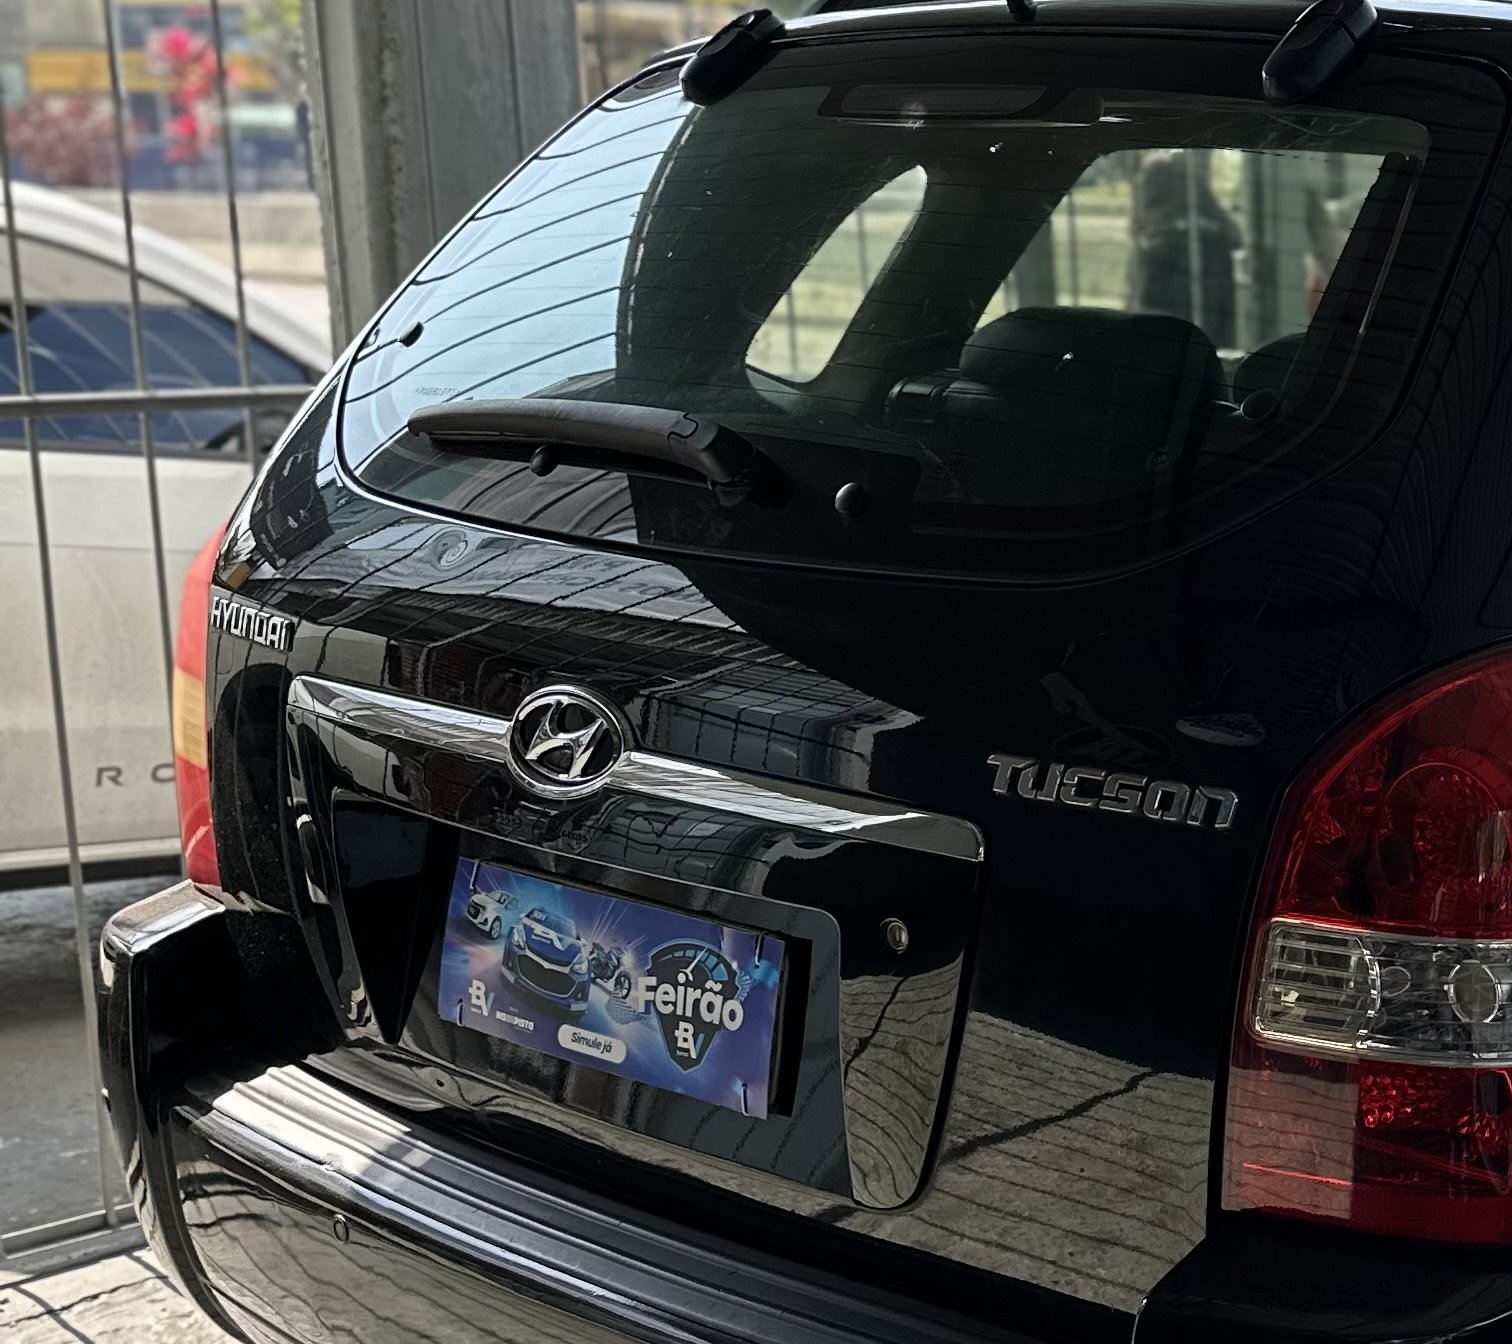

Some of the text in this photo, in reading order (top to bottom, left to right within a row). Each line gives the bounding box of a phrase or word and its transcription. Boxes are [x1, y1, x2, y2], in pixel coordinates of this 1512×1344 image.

[210, 596, 290, 651] HYUNDAI
[986, 753, 1239, 828] TUCSON
[637, 972, 744, 1031] Feirão
[571, 1031, 613, 1054] Simule já
